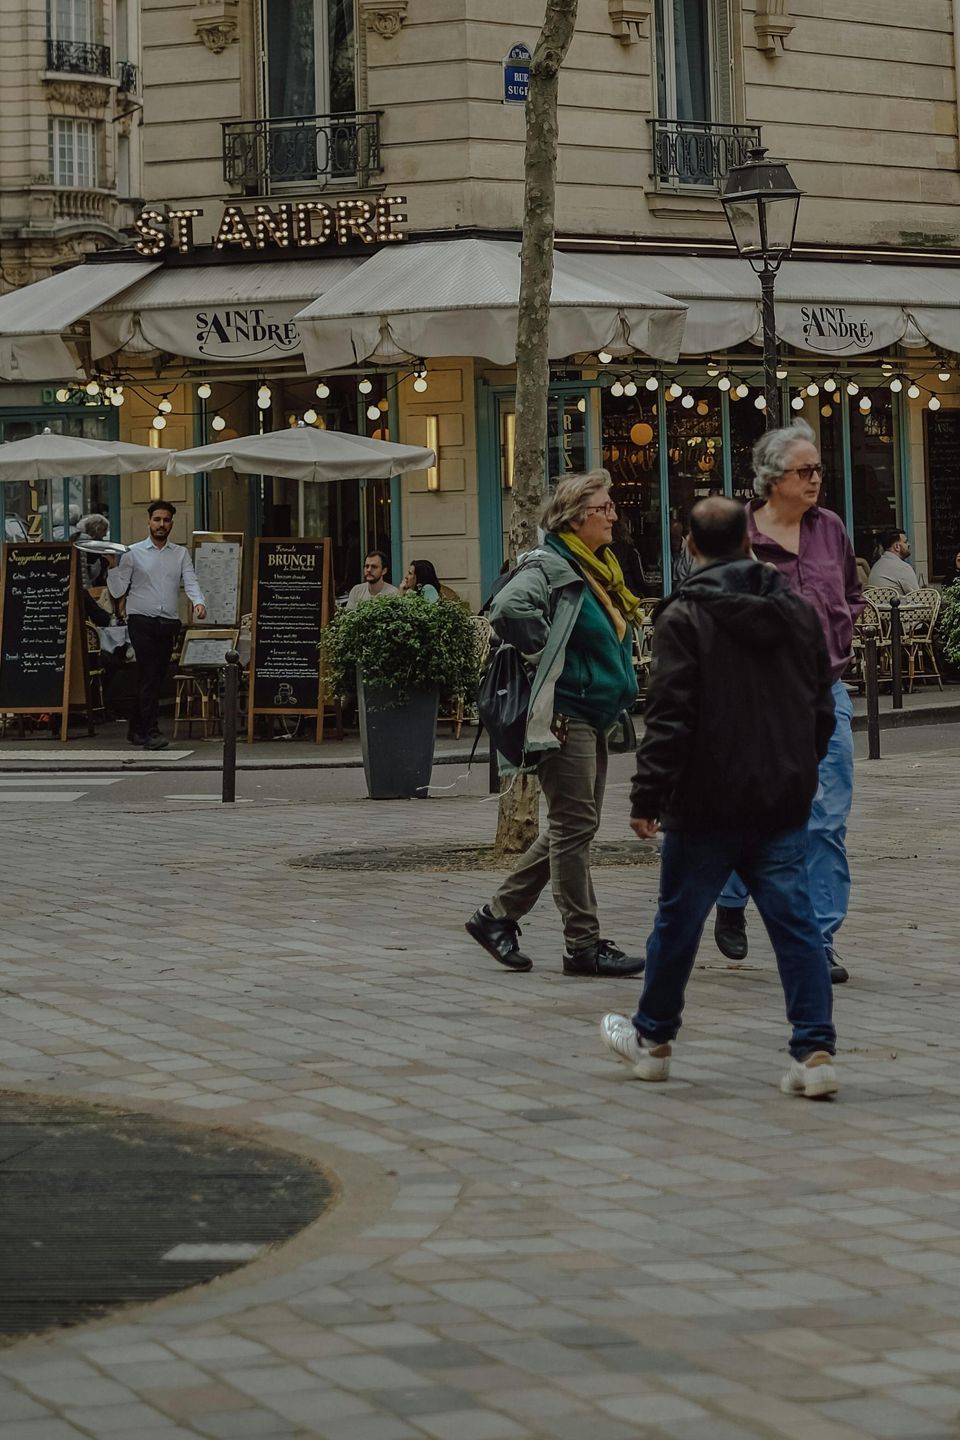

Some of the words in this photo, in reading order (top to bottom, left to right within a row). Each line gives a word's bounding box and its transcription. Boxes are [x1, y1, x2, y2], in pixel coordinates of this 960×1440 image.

[514, 72, 529, 82] RUE
[508, 85, 529, 95] SUGE
[134, 209, 203, 255] ST
[215, 196, 407, 250] ANDRE
[197, 314, 297, 345] ANDRÉ
[803, 314, 869, 343] ANDRÉ
[268, 554, 316, 566] BRUNCH
